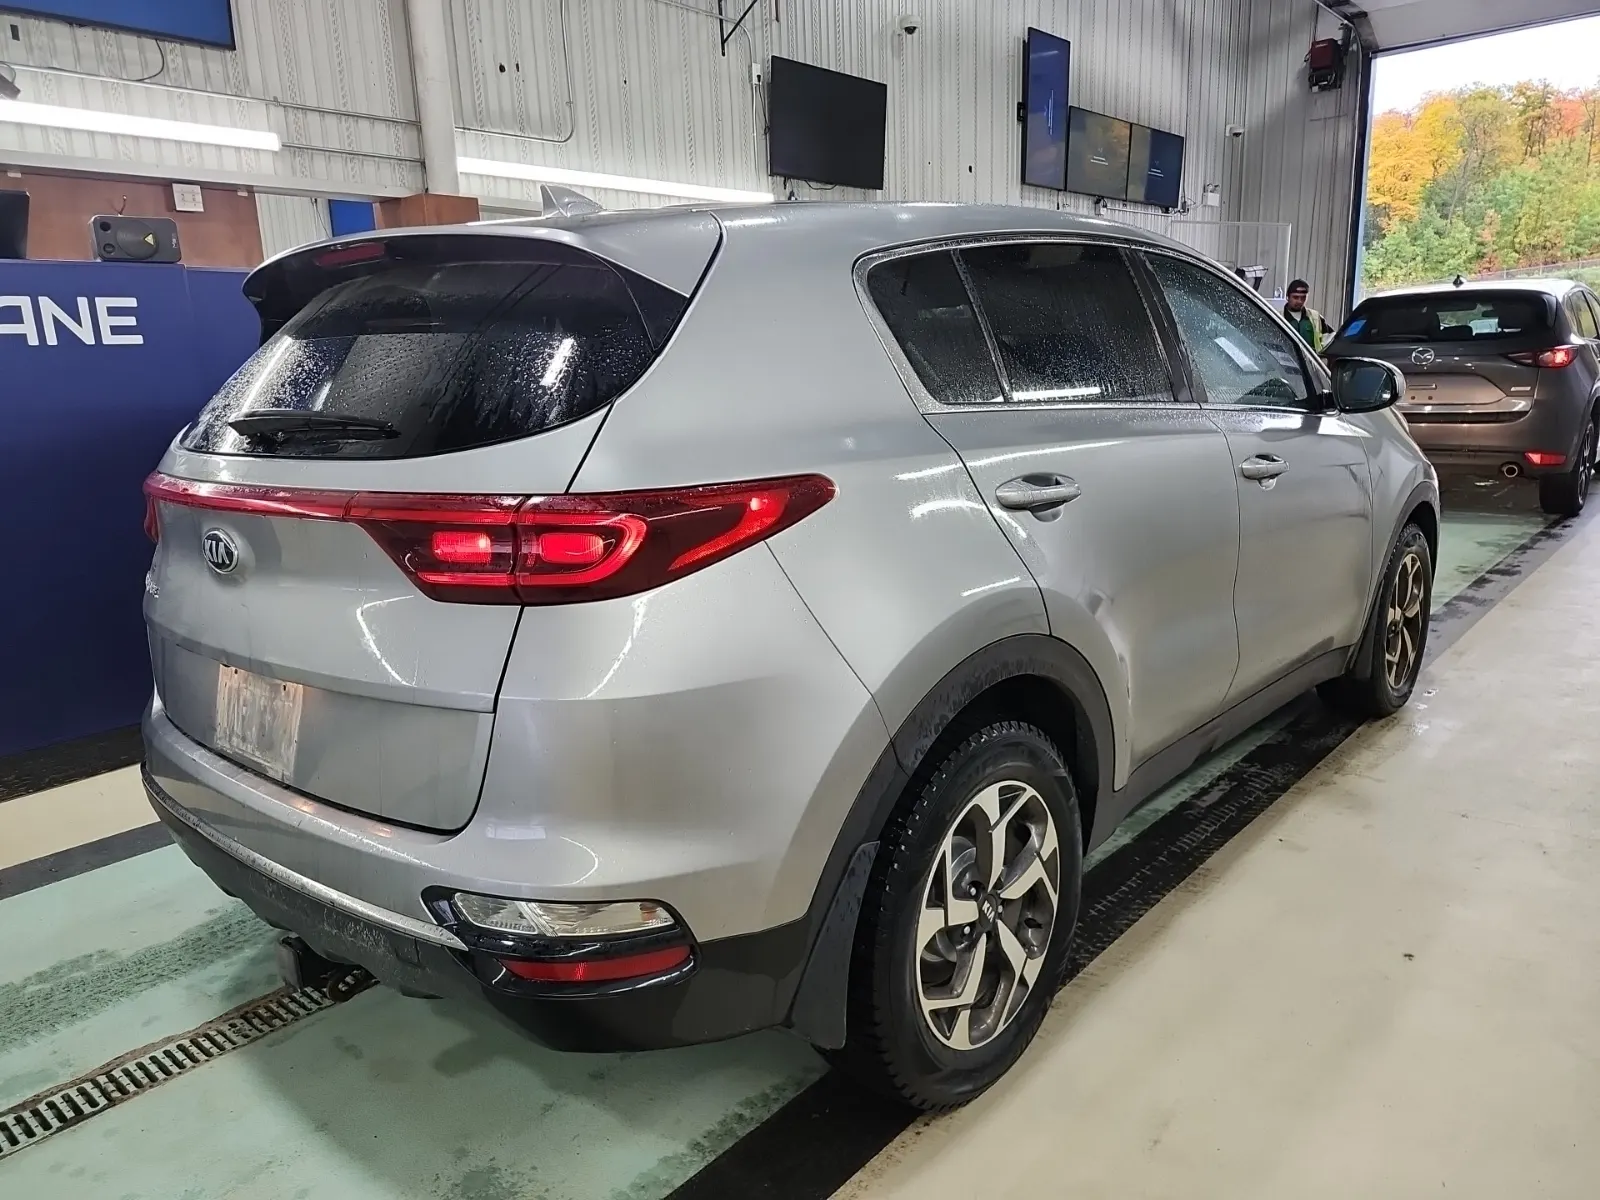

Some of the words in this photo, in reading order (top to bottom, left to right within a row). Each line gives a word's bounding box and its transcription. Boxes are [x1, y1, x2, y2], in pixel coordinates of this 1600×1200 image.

[0, 295, 144, 346] ANE
[204, 538, 230, 564] KIA
[982, 900, 995, 923] KIA
